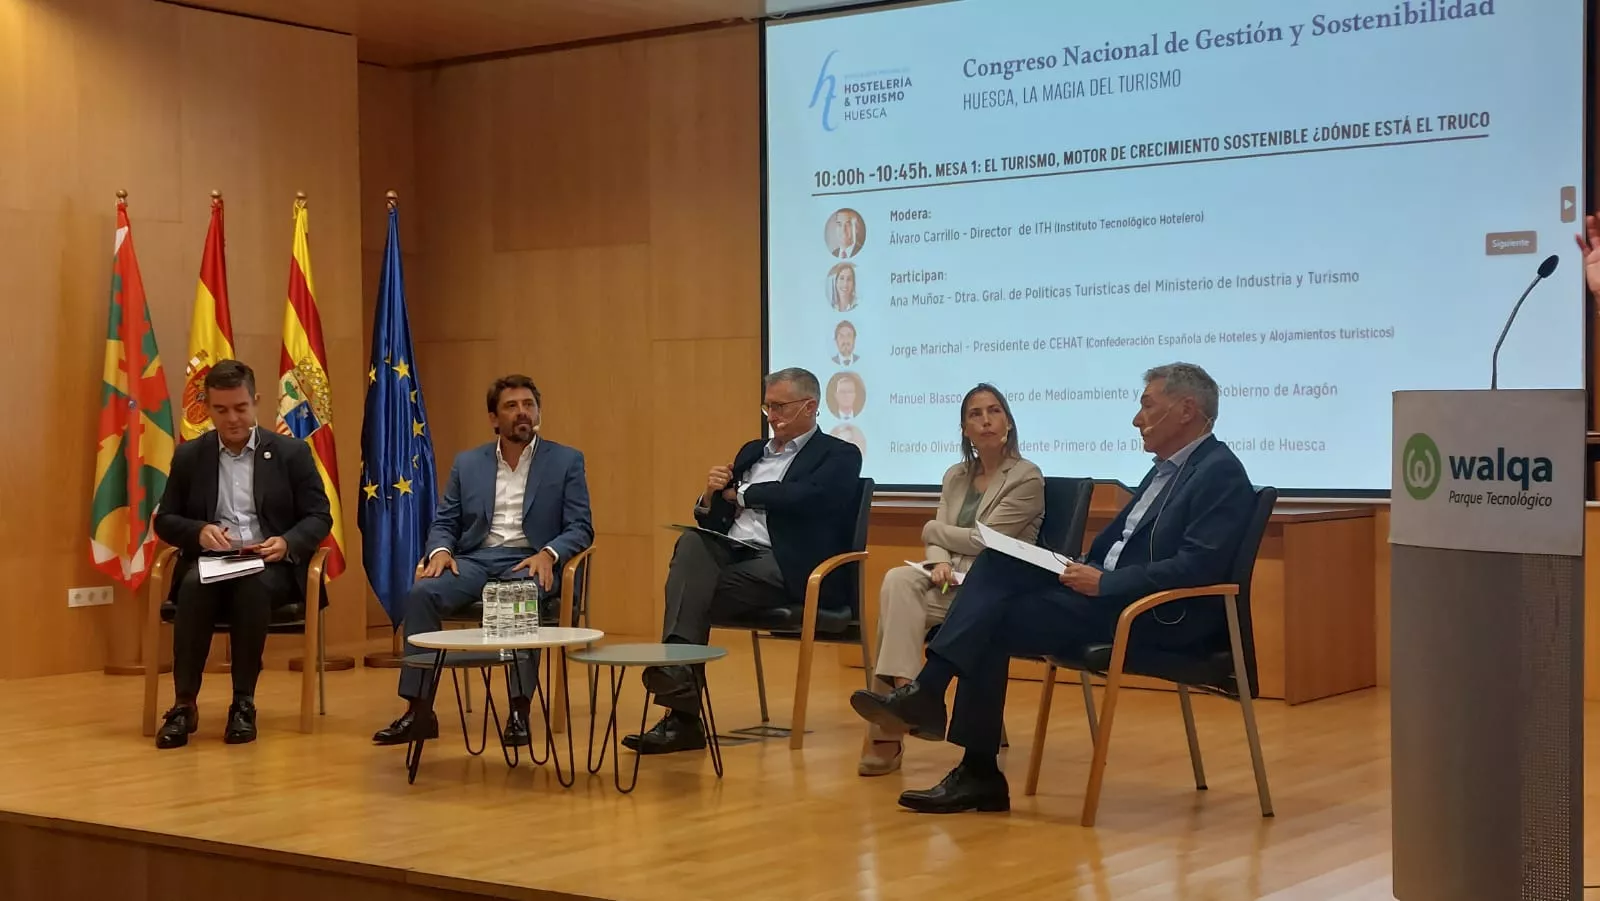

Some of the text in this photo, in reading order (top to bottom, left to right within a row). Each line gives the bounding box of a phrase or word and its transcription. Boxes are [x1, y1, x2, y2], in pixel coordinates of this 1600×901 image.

[963, 0, 1495, 81] Congreso Nacional de Gestión y Sostenibilidad
[844, 91, 905, 107] & TURISMO
[963, 69, 1182, 111] HUESCA, LA MAGIA DEL TURISMO
[844, 107, 887, 121] HUESCA
[814, 168, 865, 188] 10:00h
[935, 161, 968, 177] MESA
[971, 159, 981, 174] 1:
[984, 158, 998, 173] EL
[1001, 152, 1060, 171] TURISMO,
[1063, 148, 1107, 166] MOTOR
[1111, 145, 1126, 161] DE
[1130, 136, 1219, 159] CRECIMIENTO
[1223, 128, 1308, 151] SOSTENIBLE
[1313, 122, 1370, 143] ¿DÓNDE
[1375, 115, 1412, 137] ESTÁ
[1417, 117, 1433, 134] EL
[1438, 111, 1490, 132] TRUCO
[890, 209, 931, 222] Modera:
[890, 231, 920, 245] Álvaro
[924, 228, 960, 243] Carrillo
[970, 225, 1012, 240] Director
[1018, 224, 1032, 236] de
[1035, 222, 1051, 235] ITH
[1054, 219, 1098, 234] (Instituto
[1100, 216, 1157, 230] Tecnológico
[1160, 211, 1204, 225] Hotelero)
[890, 269, 947, 285] Participan:
[890, 295, 908, 307] Ana
[912, 292, 945, 306] Muñoz
[955, 291, 979, 304] Dtra.
[982, 289, 1005, 303] Gral.
[1009, 287, 1022, 300] de
[1134, 280, 1151, 293] del
[1155, 277, 1213, 293] Ministerio
[1217, 275, 1232, 289] de
[1236, 273, 1292, 288] Industria
[1296, 275, 1304, 288] y
[1308, 270, 1359, 285] Turismo
[890, 344, 918, 358] Jorge
[921, 341, 962, 355] Marichal
[973, 338, 1030, 352] Presidente
[1033, 337, 1046, 350] de
[1050, 336, 1083, 350] CEHAT
[1158, 333, 1201, 347] Española
[1204, 332, 1217, 344] de
[1219, 331, 1257, 343] Hoteles
[1260, 333, 1266, 344] y
[1269, 328, 1336, 343] Alojamientos
[890, 392, 926, 405] Manuel
[929, 391, 961, 405] Blasco
[1029, 388, 1041, 401] de
[1045, 387, 1129, 401] Medioambiente
[1132, 389, 1139, 402] y
[1274, 384, 1288, 396] de
[1293, 382, 1338, 399] Aragón
[890, 440, 927, 453] Ricardo
[1053, 439, 1097, 452] Primero
[1100, 439, 1113, 451] de
[1117, 438, 1127, 451] la
[1260, 438, 1275, 451] de
[1279, 437, 1326, 452] Huesca
[1449, 447, 1553, 491] walqa
[1449, 490, 1553, 510] Parque Tecnológico
